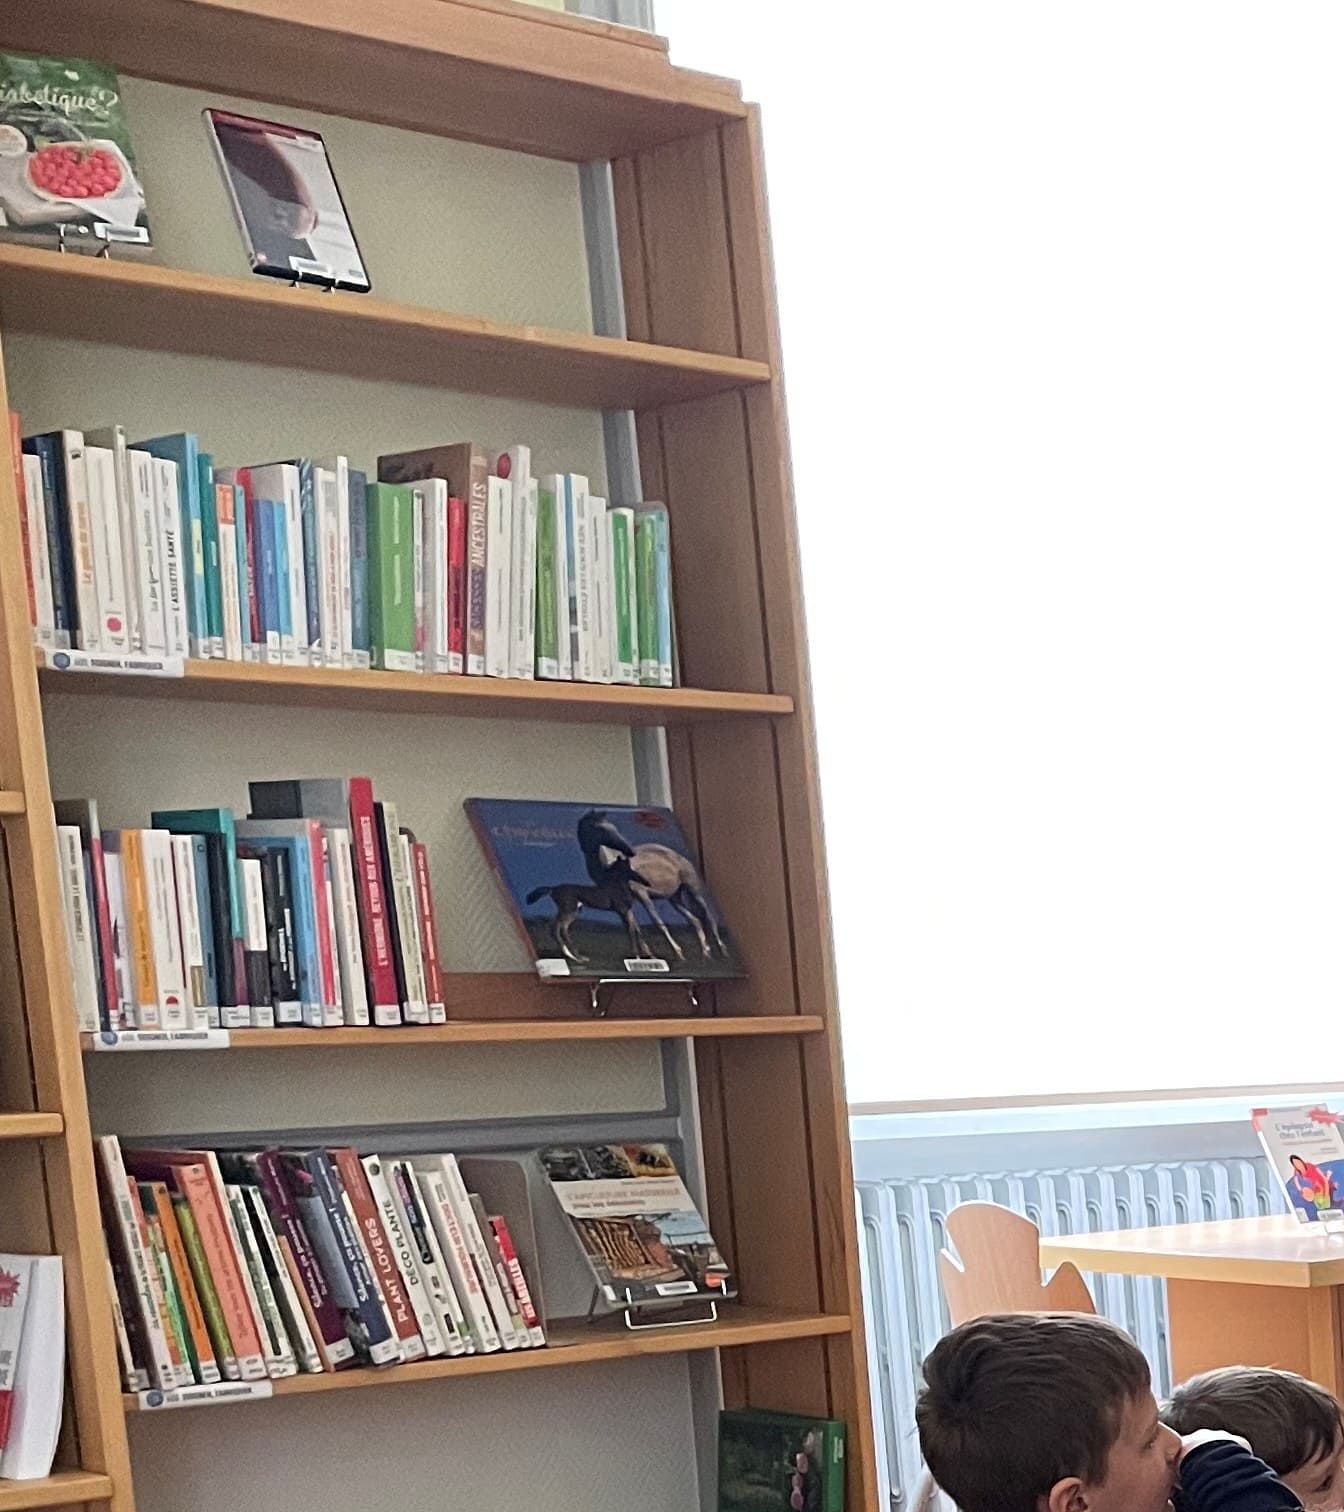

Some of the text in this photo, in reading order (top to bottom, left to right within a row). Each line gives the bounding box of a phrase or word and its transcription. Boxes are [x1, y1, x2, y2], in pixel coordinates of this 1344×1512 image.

[0, 82, 119, 118] iabolique?
[165, 529, 177, 558] SANTÉ
[472, 482, 486, 567] ANCESTRALES
[365, 1217, 408, 1322] PLANT LOVERS
[383, 1199, 419, 1285] DÉCO PLANTE
[351, 1261, 369, 1301] Silence,
